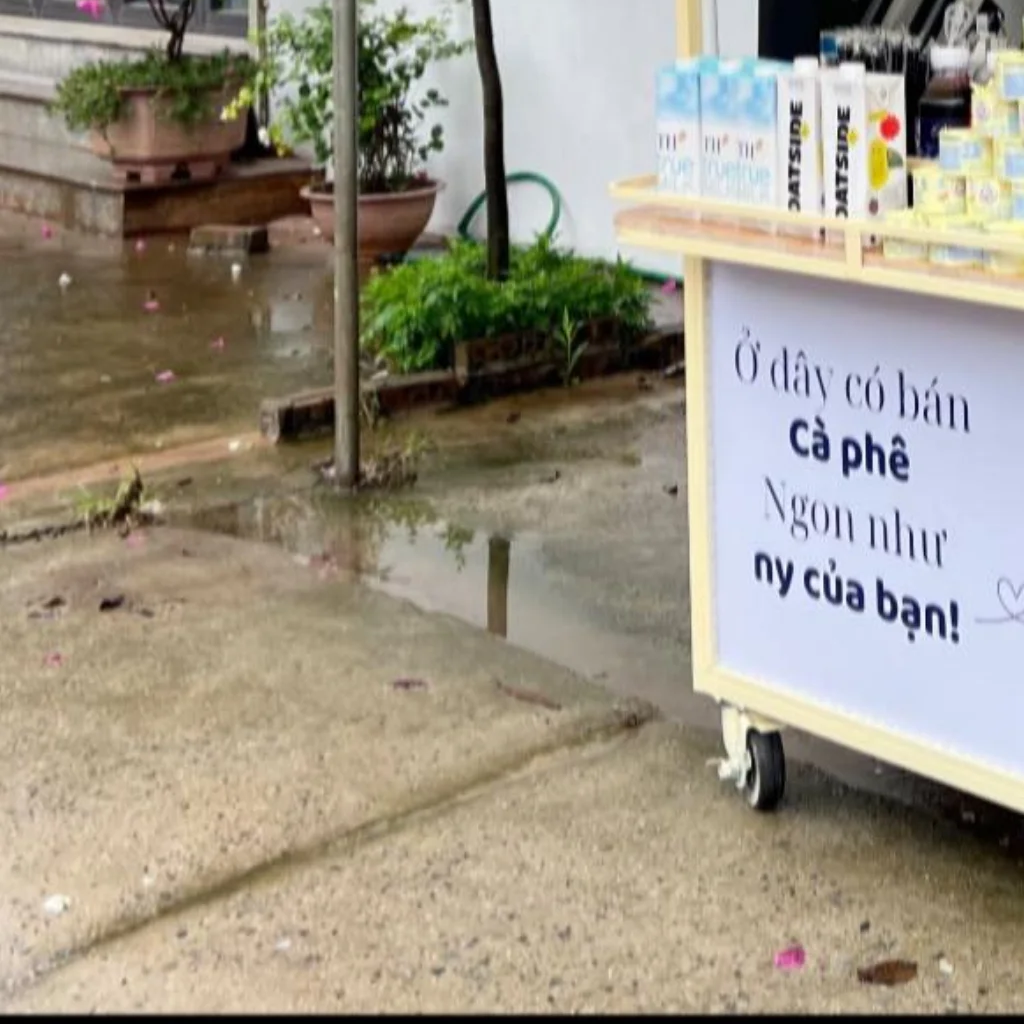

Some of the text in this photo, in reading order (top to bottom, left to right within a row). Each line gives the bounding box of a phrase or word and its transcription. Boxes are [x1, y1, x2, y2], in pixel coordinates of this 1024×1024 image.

[734, 325, 761, 384] Ở
[845, 365, 885, 414] có
[898, 369, 971, 433] bán
[789, 415, 910, 482] Cà phê
[763, 475, 948, 568] Ngon như
[754, 550, 960, 643] ny của bạn!
